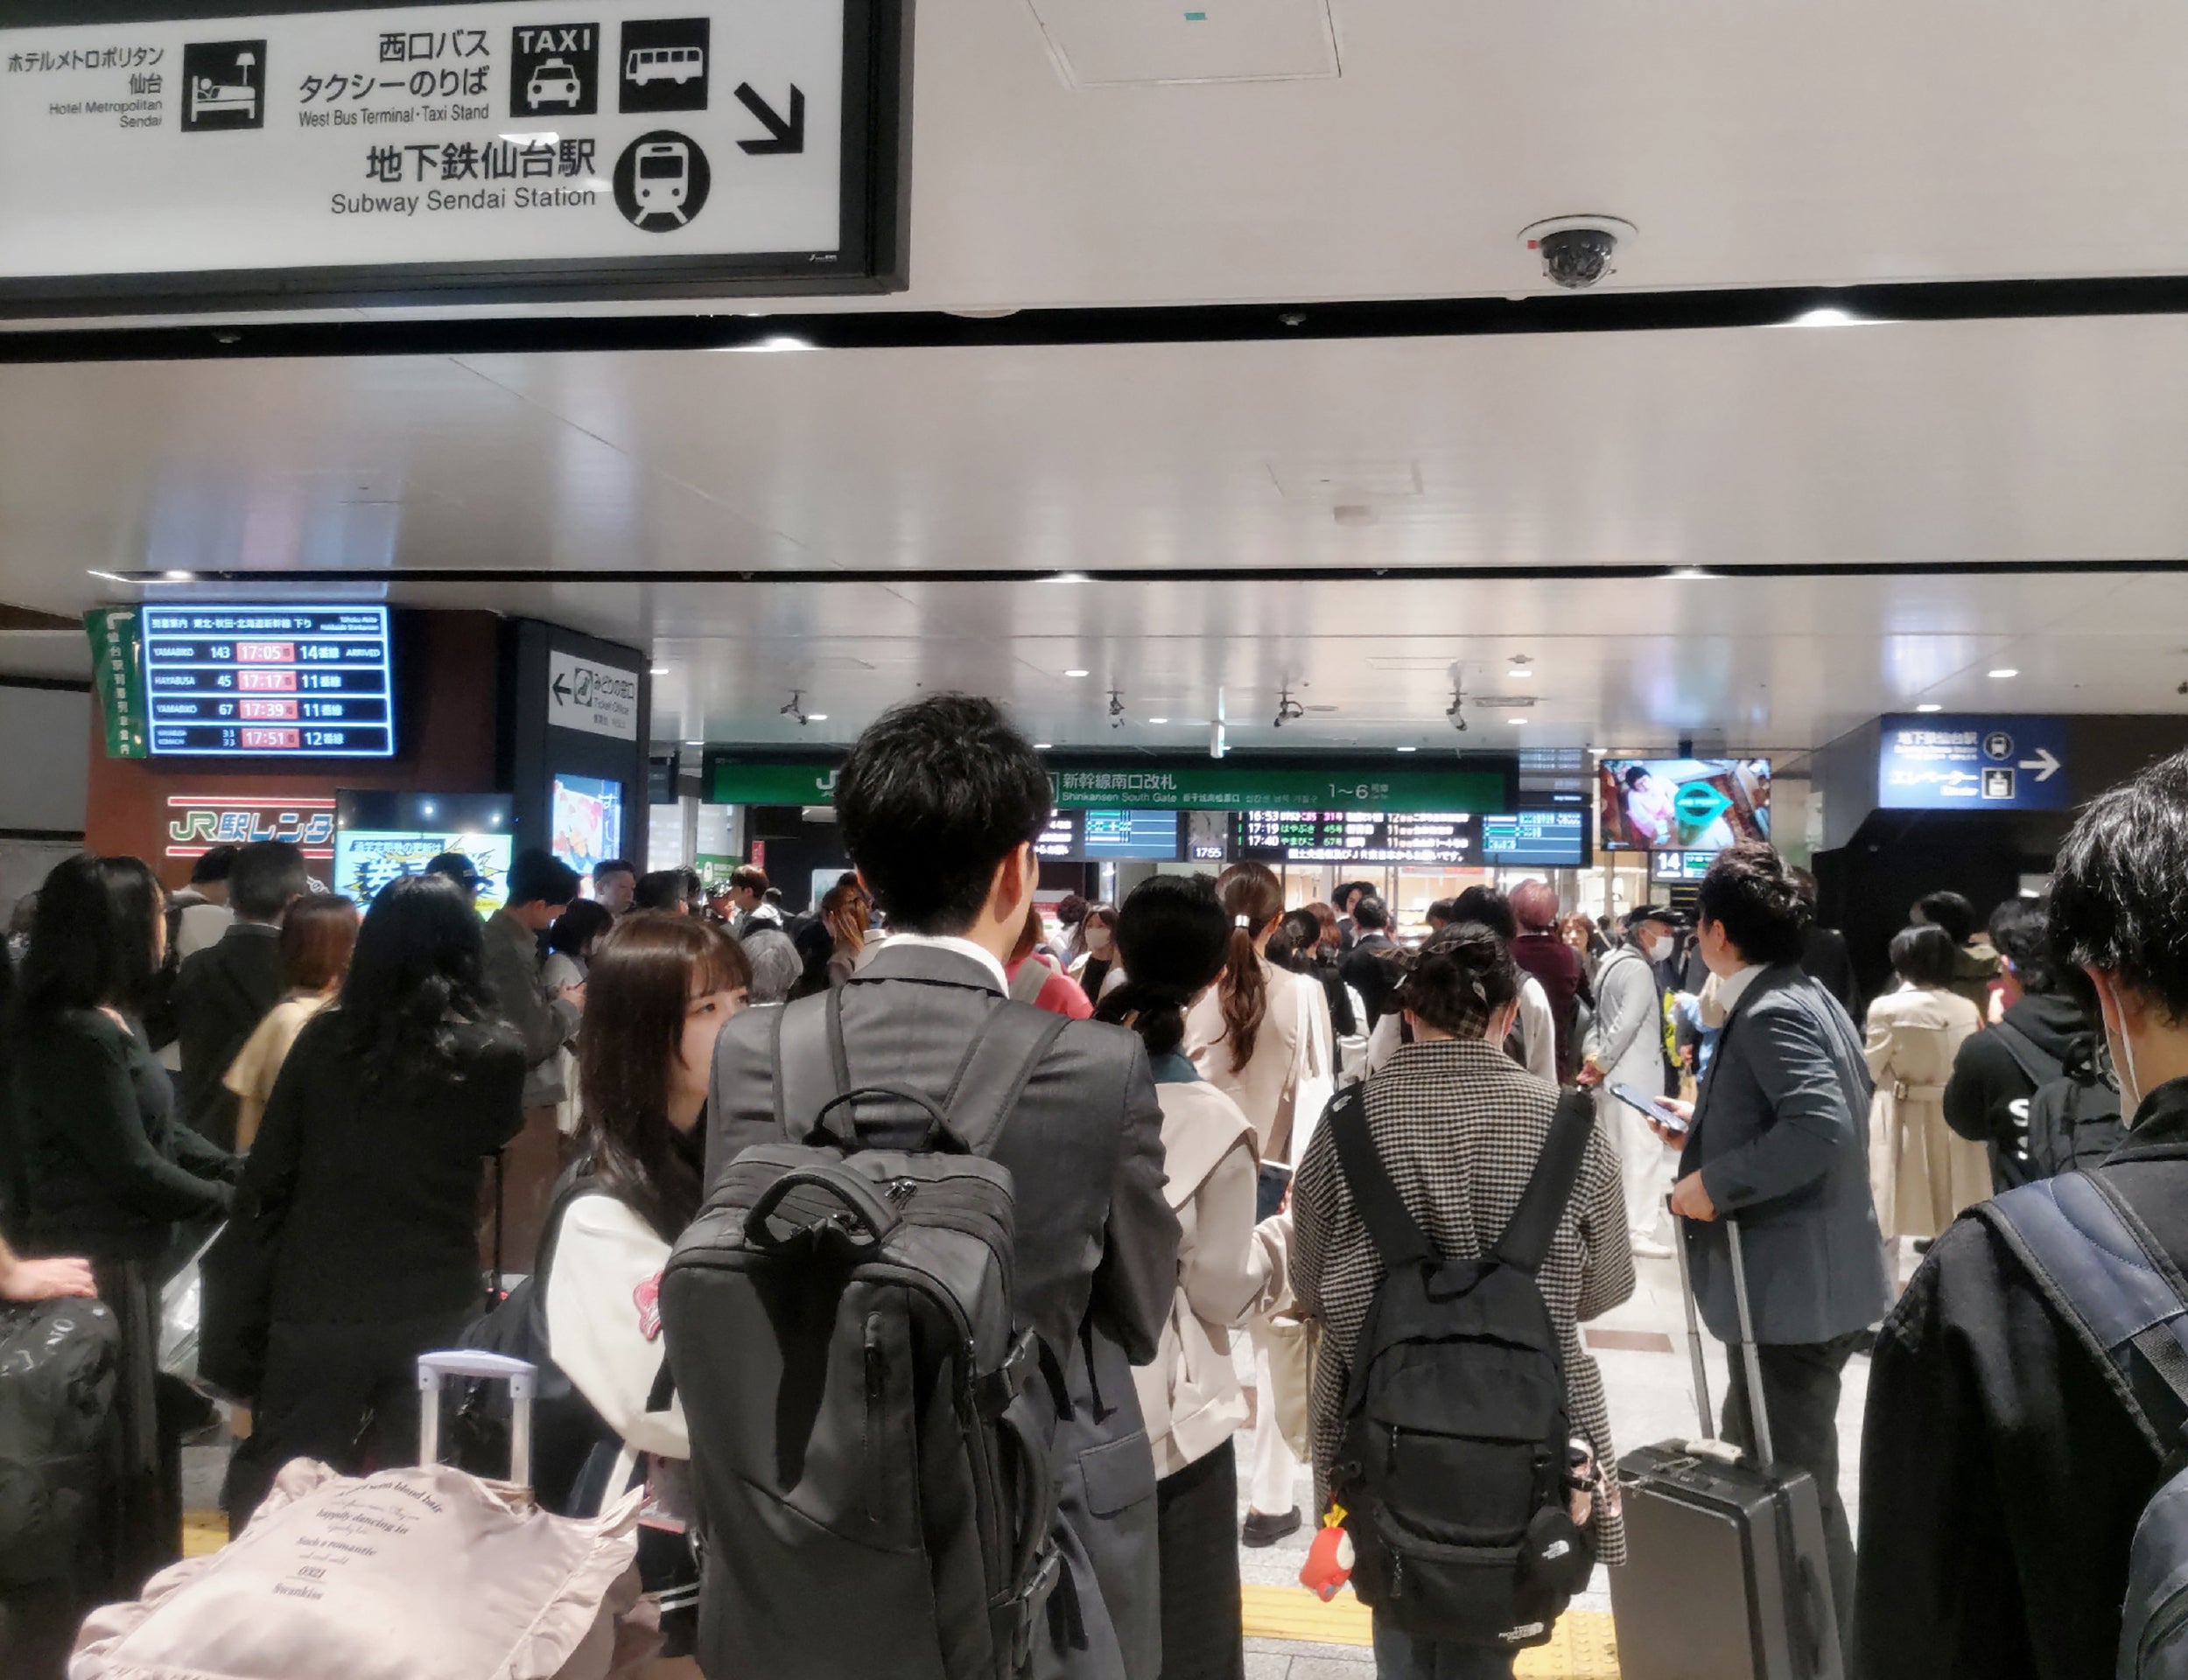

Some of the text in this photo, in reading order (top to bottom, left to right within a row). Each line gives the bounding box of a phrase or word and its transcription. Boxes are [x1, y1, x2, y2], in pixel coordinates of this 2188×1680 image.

[378, 29, 491, 62] 西口バス
[518, 29, 592, 54] TAXI
[8, 47, 165, 73] ホテルメトロポリタン
[128, 74, 164, 94] 仙台
[298, 65, 491, 103] タクシーのりば
[49, 98, 163, 115] Hotel Metropolitan
[298, 111, 331, 127] West
[333, 109, 359, 125] Bus
[451, 103, 490, 121] Stand
[119, 115, 163, 129] Sendai
[365, 139, 596, 182] 地下鉄仙台駅
[330, 185, 597, 216] Subway Sendai Station
[211, 646, 231, 659] 143
[242, 645, 282, 660] 17:05
[217, 675, 232, 688] 45
[242, 674, 282, 689] 17:17
[218, 704, 235, 716] 67
[244, 703, 284, 717] 17:39
[246, 732, 285, 746] 17:51
[1062, 773, 1177, 790] 新幹線南口改札
[1062, 791, 1177, 803] Shinkansen South Gate
[169, 810, 335, 844] JR駅レンタ
[1248, 823, 1280, 834] 17:19
[1280, 824, 1315, 835] はやぶさ
[1280, 836, 1315, 846] やまびこ
[1658, 852, 1681, 870] 14
